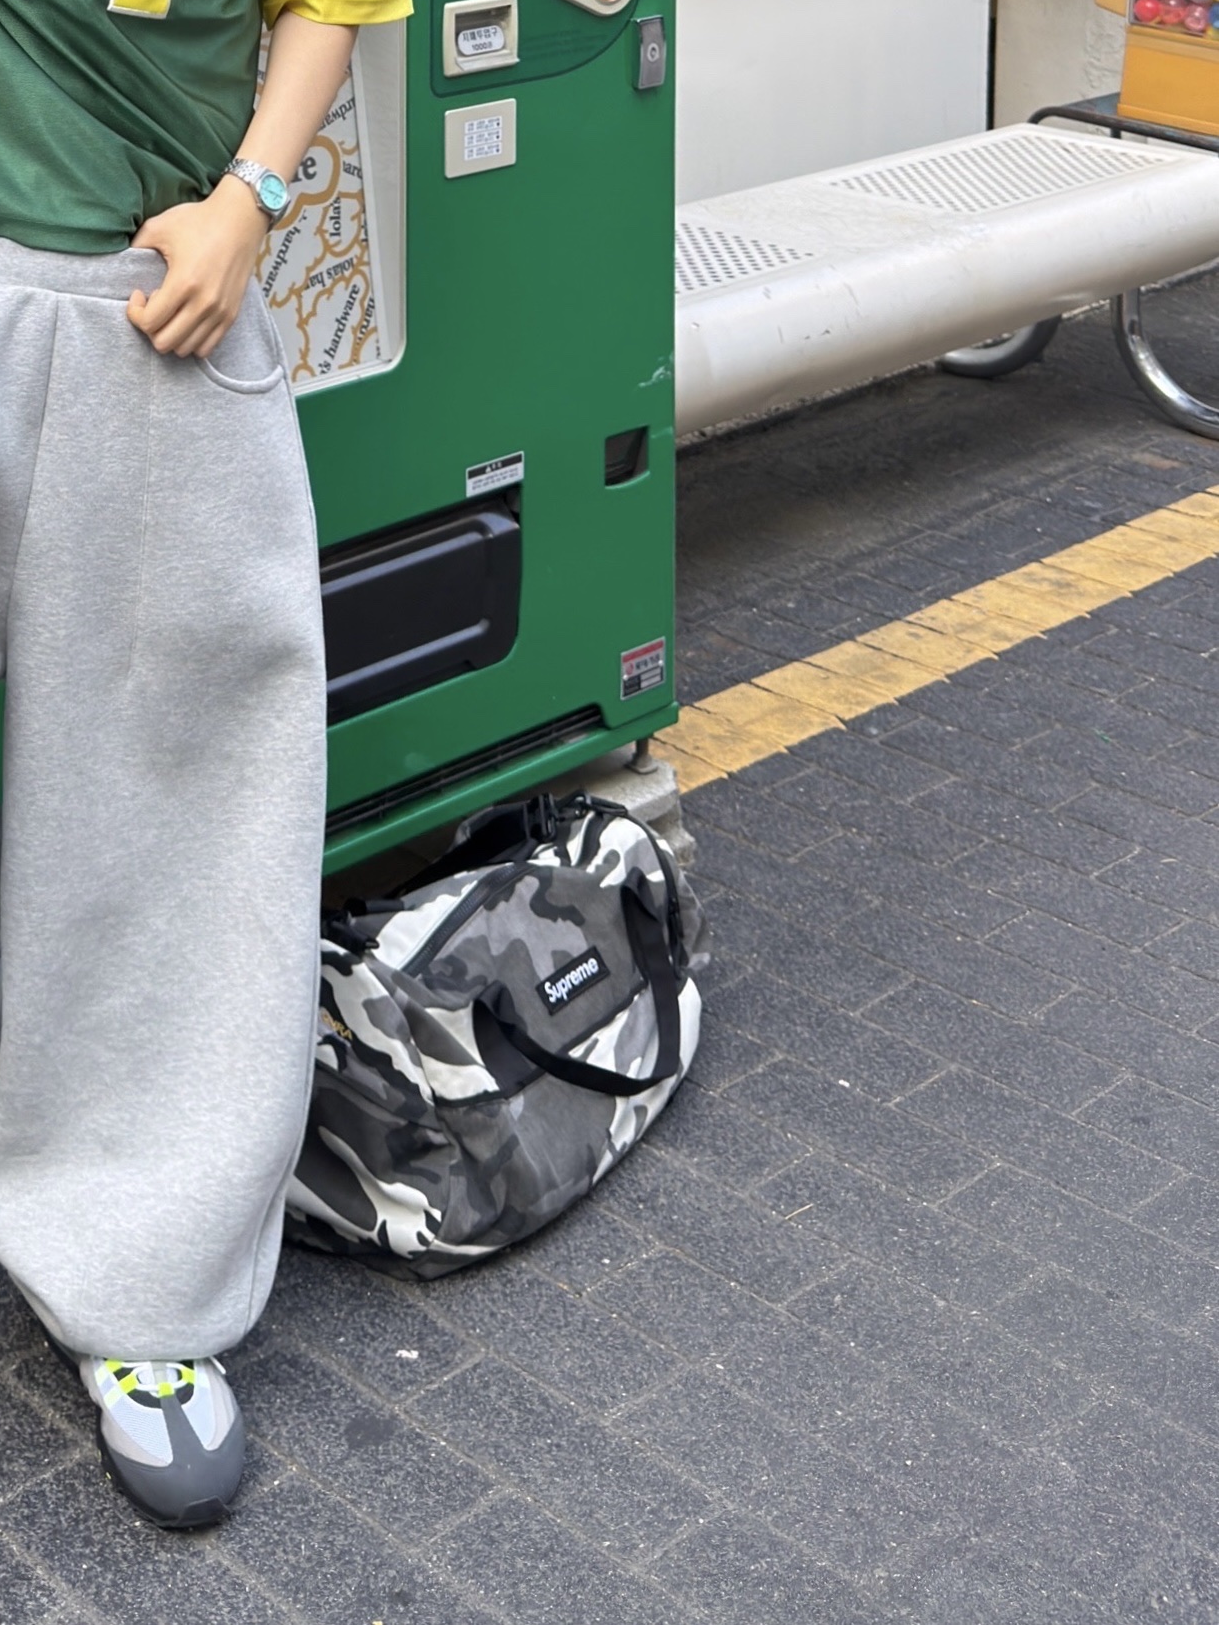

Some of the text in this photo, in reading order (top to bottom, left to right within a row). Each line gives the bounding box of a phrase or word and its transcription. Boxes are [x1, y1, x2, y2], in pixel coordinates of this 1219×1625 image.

[329, 195, 342, 238] lola's
[324, 283, 361, 362] hardware
[544, 955, 601, 1005] Supreme
